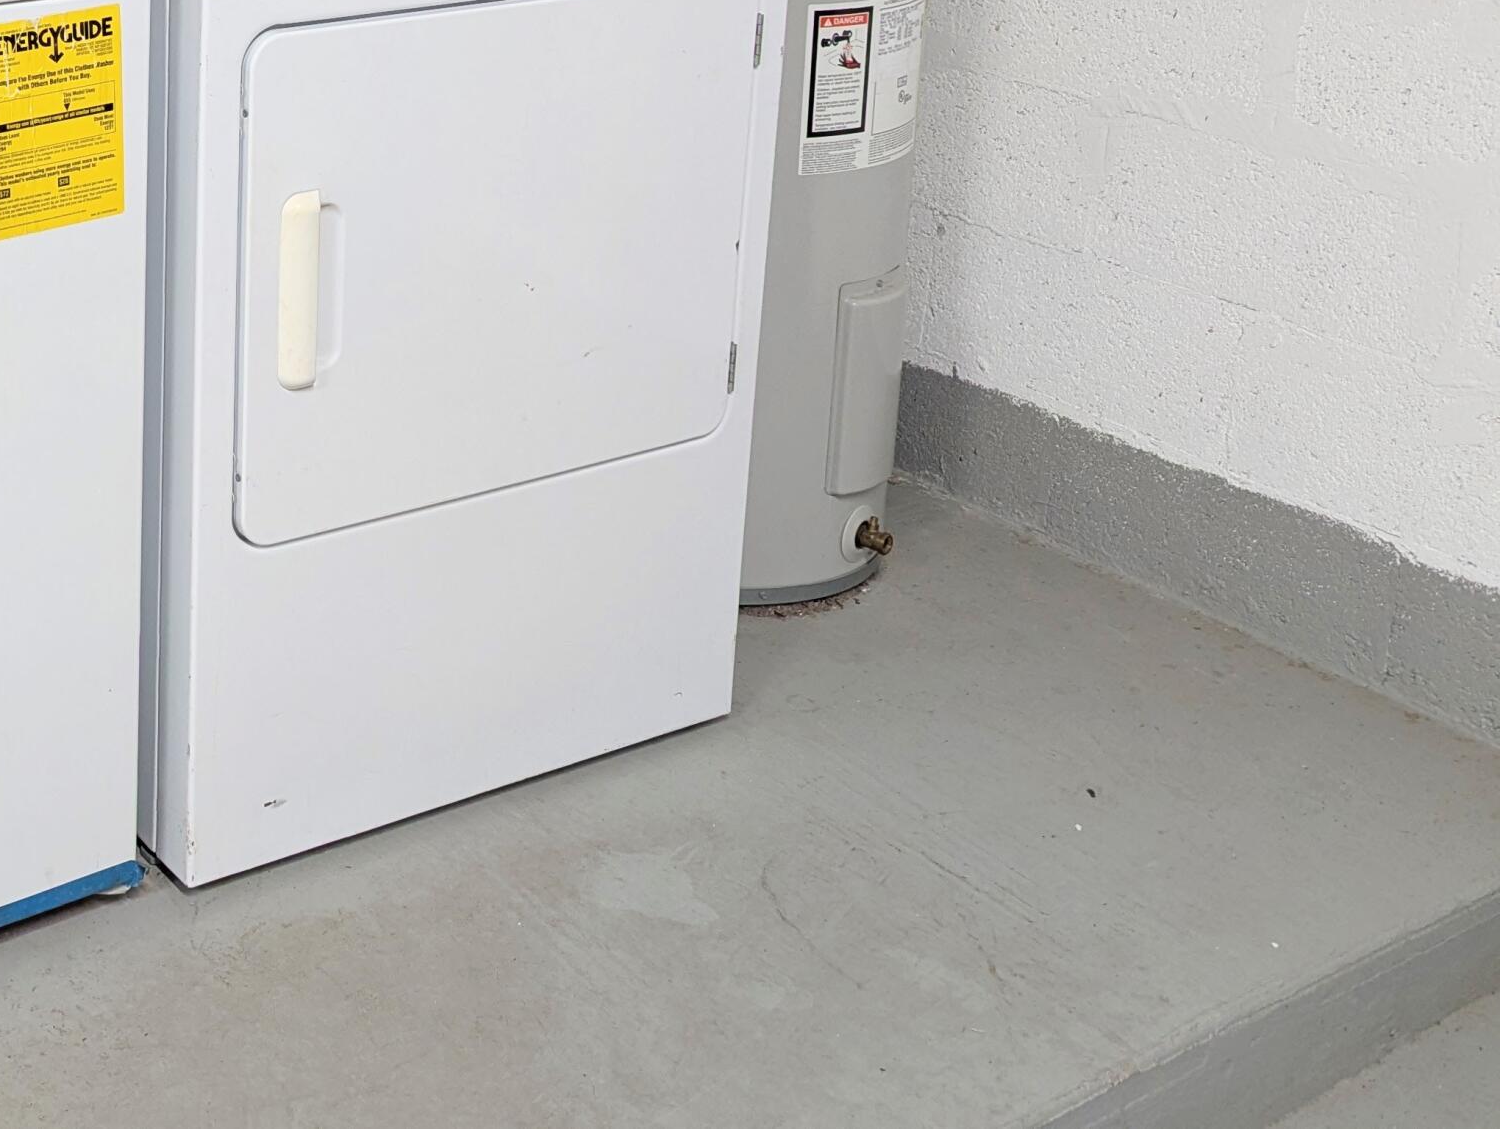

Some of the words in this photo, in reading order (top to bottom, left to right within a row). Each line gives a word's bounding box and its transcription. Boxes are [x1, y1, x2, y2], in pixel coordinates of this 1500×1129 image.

[833, 15, 865, 25] DANGER
[27, 73, 46, 82] Energy
[74, 64, 95, 72] Clothes
[30, 81, 49, 89] Others
[49, 77, 68, 85] Before
[80, 72, 92, 80] Buy.
